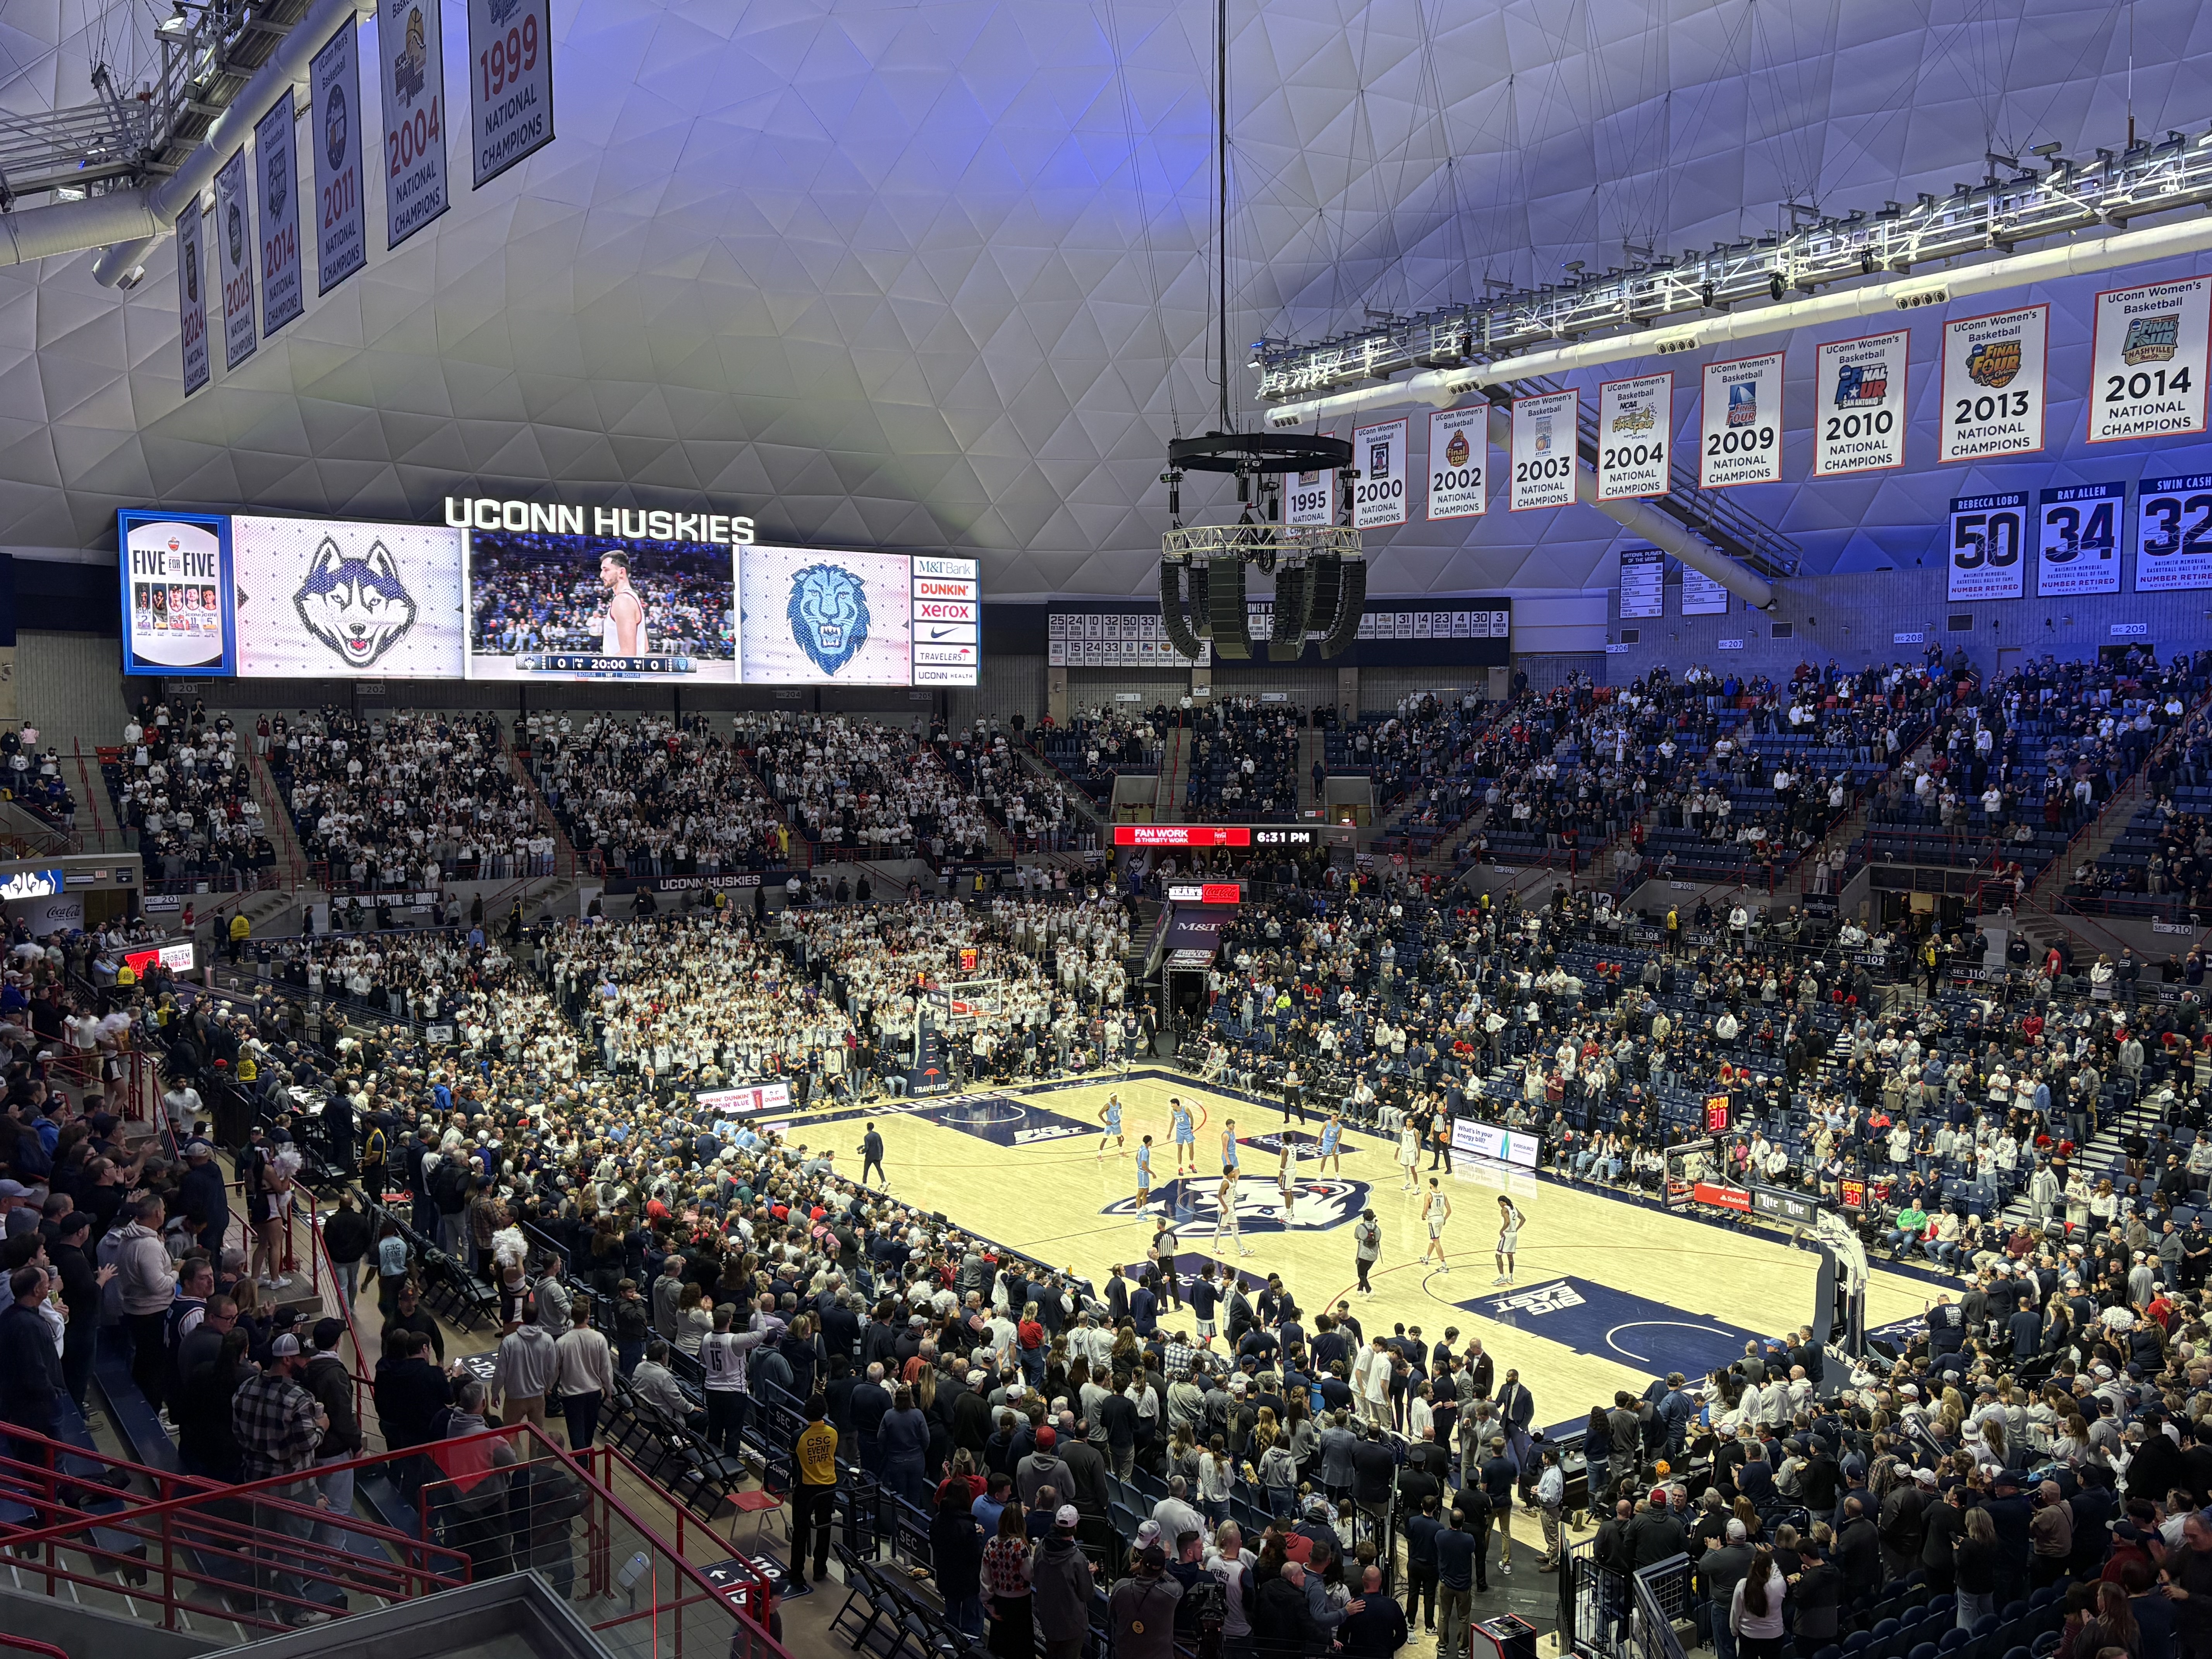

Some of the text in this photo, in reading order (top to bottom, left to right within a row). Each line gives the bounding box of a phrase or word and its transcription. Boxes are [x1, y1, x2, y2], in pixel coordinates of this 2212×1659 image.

[481, 14, 537, 102] 1999
[486, 83, 537, 136] NATIONAL
[390, 94, 439, 179] 2004
[324, 165, 354, 230] 2011
[266, 222, 294, 278] 2014
[227, 266, 249, 317] 2023
[184, 304, 204, 347] 2024
[2142, 320, 2177, 335] FINAL
[1986, 343, 2020, 359] FINAL
[2128, 348, 2171, 359] NASHVILLE
[2106, 366, 2191, 403] 2014
[1955, 391, 2029, 424] 2013
[2110, 401, 2185, 419] NATIONAL
[1827, 410, 1893, 440] 2010
[1958, 422, 2025, 440] NATIONAL
[2102, 417, 2191, 436] CHAMPIONS
[1708, 427, 1774, 456] 2009
[1830, 441, 1888, 455] NATIONAL
[1952, 437, 2030, 456] CHAMPIONS
[1604, 442, 1663, 470] 2004
[1714, 455, 1767, 469] NATIONAL
[1825, 454, 1893, 471] CHAMPIONS
[1517, 457, 1570, 482] 2003
[1709, 469, 1771, 483] CHAMPIONS
[1434, 467, 1481, 491] 2002
[2157, 476, 2211, 490] SWIN CASH
[1357, 479, 1402, 503] 2000
[2057, 486, 2106, 500] RAY ALLEN
[1291, 490, 1326, 512] 1995
[1958, 495, 2018, 510] REBECCA LOBO
[445, 497, 754, 545] UCONN HUSKIES
[2144, 494, 2212, 556] 32
[2047, 502, 2115, 563] 34
[1954, 512, 2020, 569] 50
[133, 550, 215, 577] FIVE FOR FIVE
[919, 560, 970, 575] M&T Bank
[921, 583, 969, 596] DUNKIN'
[921, 604, 969, 618] xerox
[1248, 603, 1273, 613] OMEN'S
[1051, 617, 1064, 625] 25
[1068, 617, 1082, 625] 24
[1089, 617, 1098, 625] 10
[1105, 617, 1118, 625] 32
[1123, 617, 1136, 625] 50
[1141, 617, 1154, 625] 33
[1399, 615, 1409, 623] 31
[1418, 614, 1429, 623] 14
[1435, 614, 1449, 623] 23
[1457, 614, 1465, 623] 4
[1474, 613, 1487, 622] 30
[1496, 613, 1503, 622] 3
[2126, 625, 2145, 634] 209
[1906, 634, 1923, 642] 208
[1071, 643, 1080, 652] 15
[1087, 643, 1101, 652] 24
[1105, 643, 1118, 652] 33
[557, 658, 566, 668] 0
[592, 659, 627, 670] 20:00
[651, 660, 659, 670] 0
[921, 653, 962, 661] TRAVELERS
[1257, 832, 1310, 842] 6:31 PM
[660, 875, 761, 890] UCONN HUSKIES
[1169, 888, 1202, 896] BEAR'S
[1204, 886, 1237, 897] Coca-Cola
[47, 904, 80, 919] Coca-Cola
[1176, 922, 1221, 931] M&T
[2171, 924, 2191, 934] 210
[959, 948, 976, 957] 20:00
[961, 956, 975, 970] 30
[1867, 955, 1885, 965] 109
[1968, 969, 1986, 979] 110
[914, 1083, 949, 1093] TRAVELERS
[864, 1089, 1023, 1115] HUSKIES
[1708, 1096, 1729, 1110] 20:00
[1709, 1108, 1727, 1130] 30
[1014, 1125, 1061, 1137] BIG
[1015, 1126, 1083, 1144] EAST
[1458, 1125, 1475, 1133] What's
[1457, 1133, 1474, 1142] energy
[1842, 1181, 1863, 1193] 20:00
[1436, 1199, 1441, 1207] 11
[1759, 1194, 1805, 1215] Lite Lite
[1845, 1192, 1860, 1205] 30
[1512, 1212, 1516, 1221] 2
[1493, 1286, 1576, 1313] EAST
[1526, 1293, 1587, 1316] BIG
[710, 1350, 722, 1372] 15
[1803, 1394, 1812, 1408] 24
[776, 1410, 791, 1429] SEC
[807, 1436, 831, 1447] CSC
[807, 1444, 831, 1456] EVENT
[808, 1453, 829, 1465] STAFF
[898, 1529, 917, 1550] SEC
[1211, 1568, 1230, 1582] SPENCER
